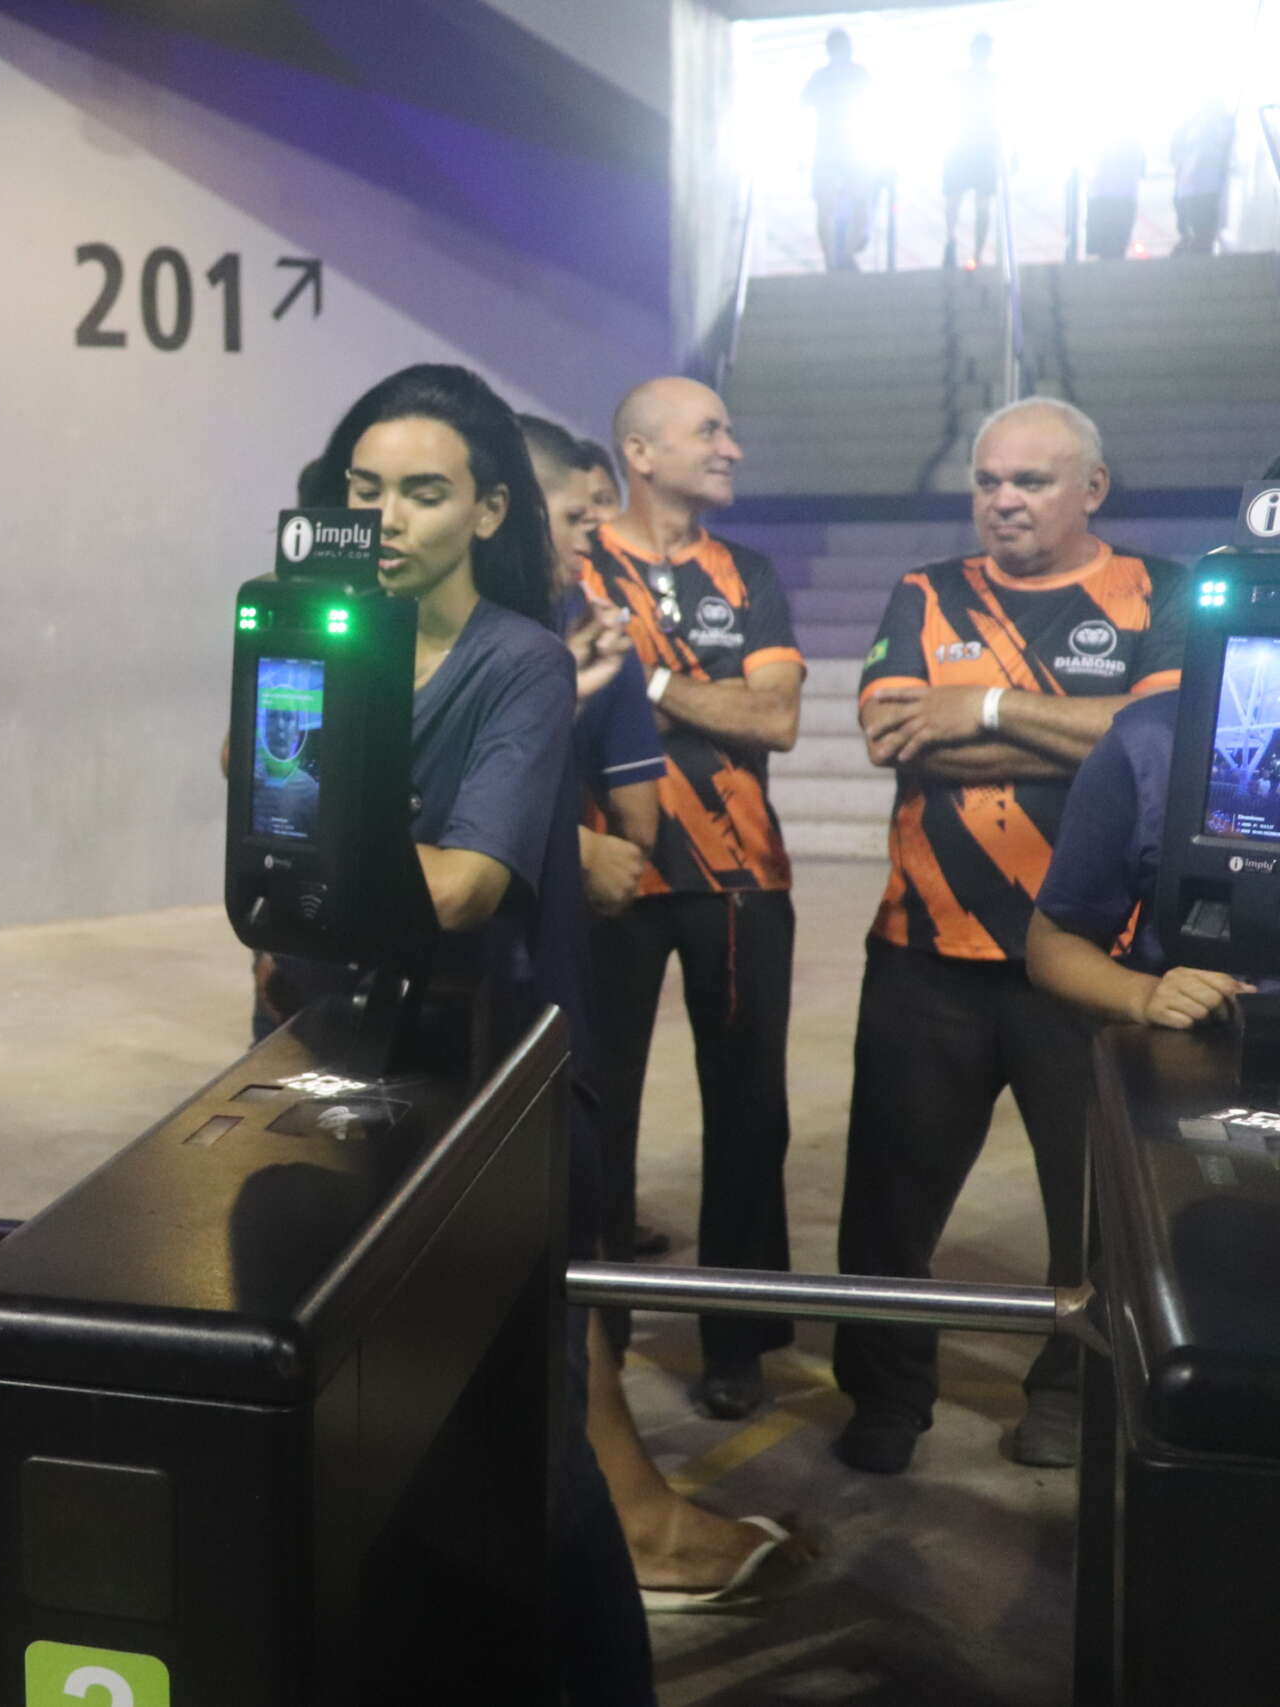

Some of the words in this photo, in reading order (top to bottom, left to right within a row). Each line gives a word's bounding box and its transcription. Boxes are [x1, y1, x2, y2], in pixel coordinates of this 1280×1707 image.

[75, 243, 242, 353] 201
[315, 521, 372, 549] imply
[1054, 656, 1126, 673] DIAMOND
